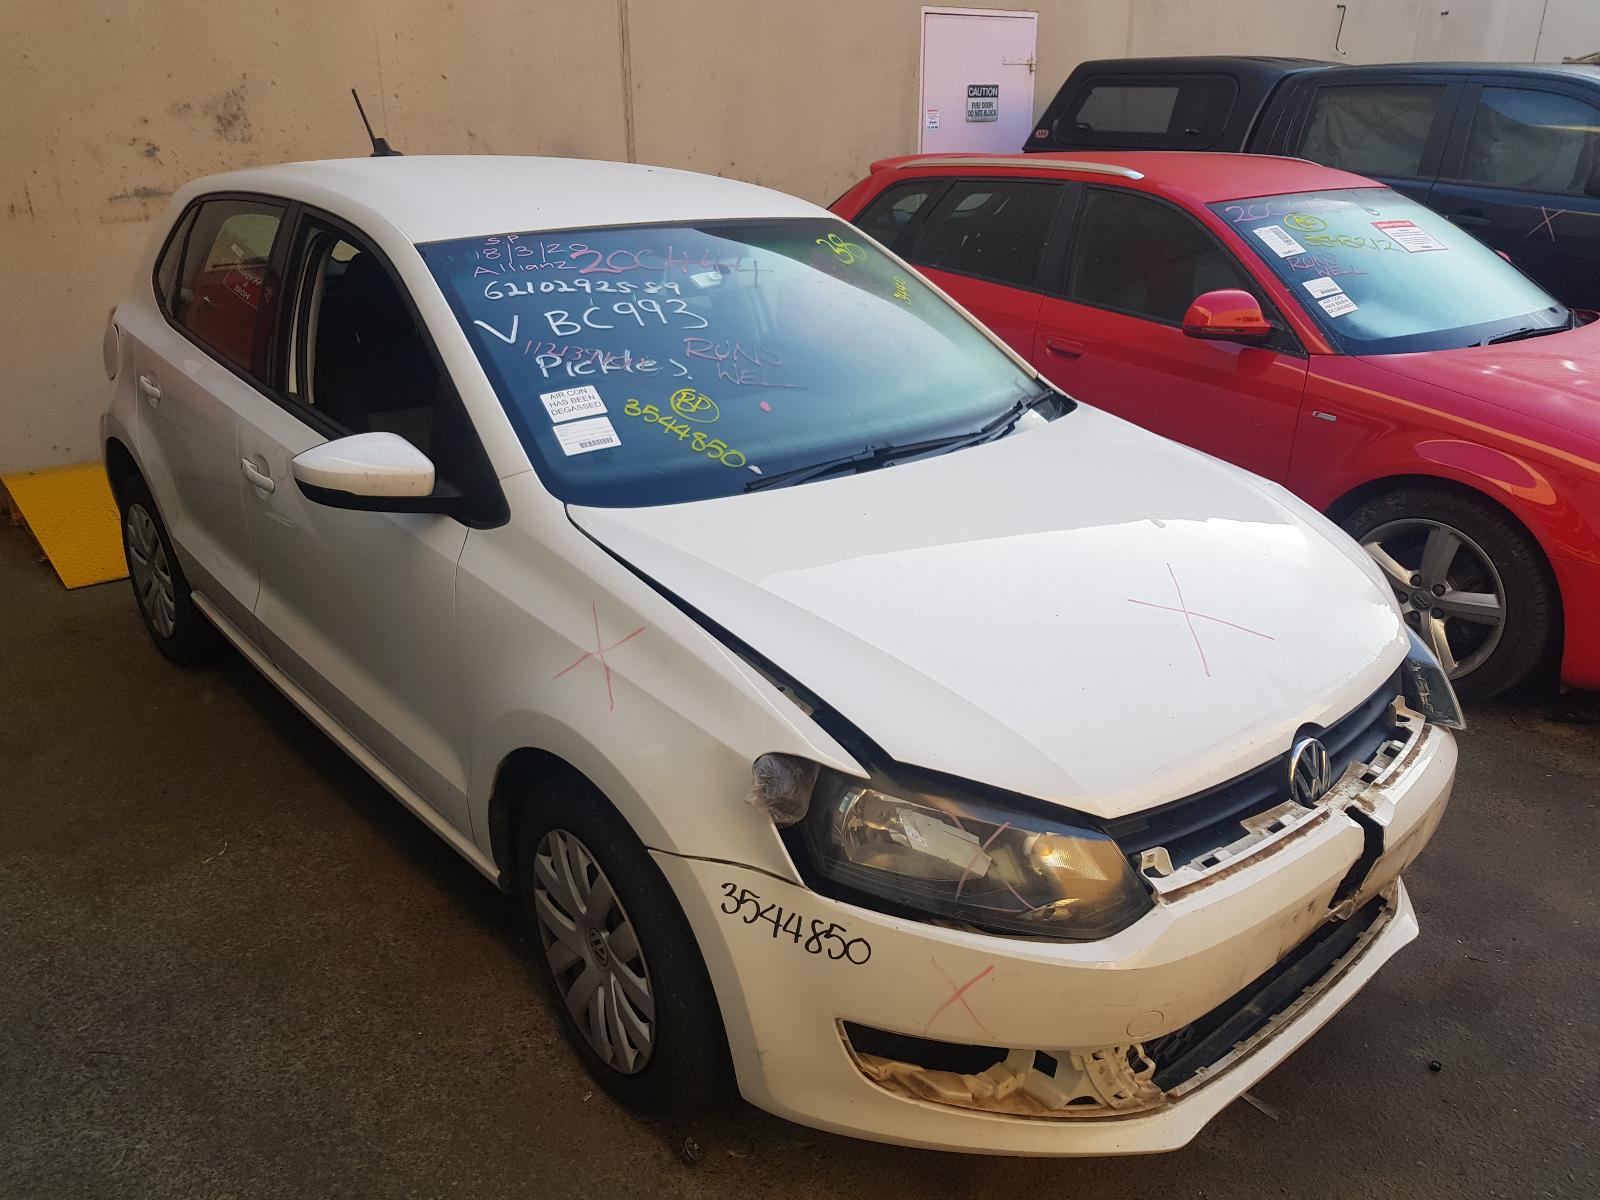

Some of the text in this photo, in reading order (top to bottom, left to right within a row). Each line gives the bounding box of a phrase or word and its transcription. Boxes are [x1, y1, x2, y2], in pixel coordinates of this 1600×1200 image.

[968, 87, 998, 97] CAUTION
[971, 101, 994, 109] FIRE DOOR
[983, 109, 997, 117] BLOCK
[683, 337, 782, 367] RUNS
[549, 394, 596, 408] HAS BEEN
[550, 388, 588, 400] AIR CON
[550, 401, 602, 416] DEGASSED
[623, 398, 747, 468] 3544850
[720, 882, 872, 965] 3544850
